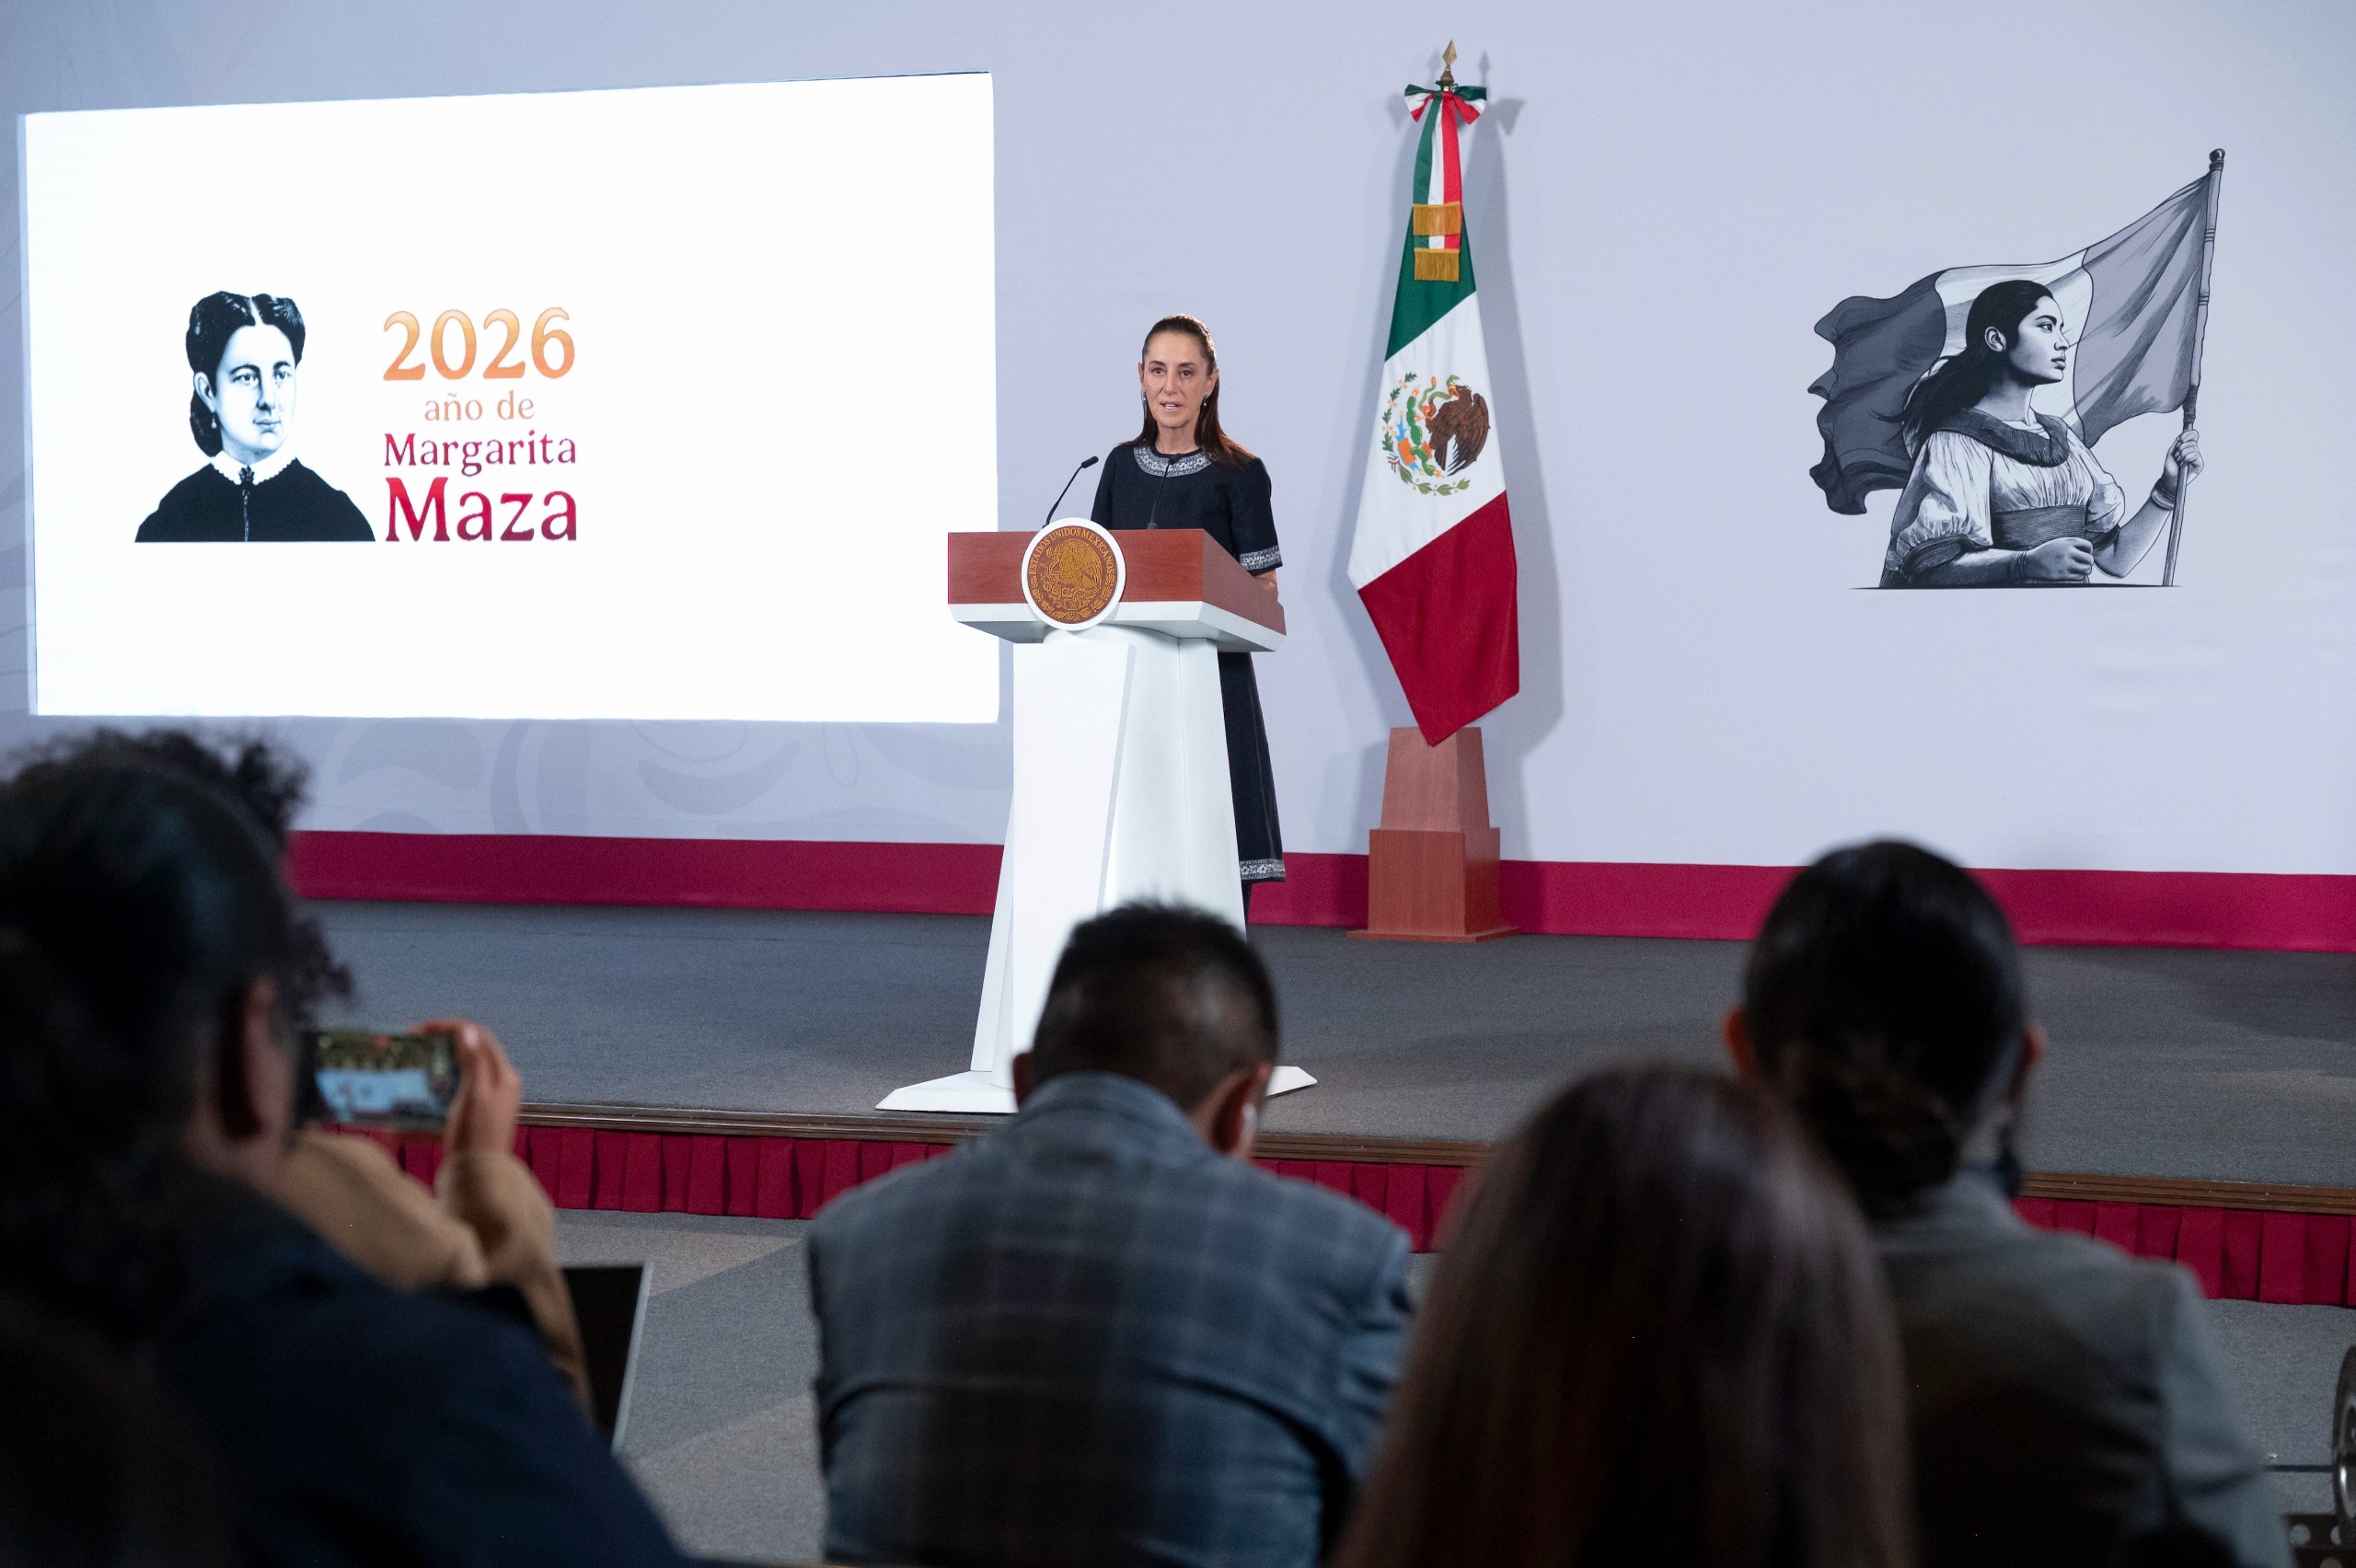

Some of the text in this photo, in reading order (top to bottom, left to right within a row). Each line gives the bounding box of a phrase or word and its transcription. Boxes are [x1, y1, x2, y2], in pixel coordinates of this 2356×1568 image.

[383, 306, 575, 381] 2026
[424, 389, 535, 421] año de
[384, 429, 576, 478] Margarita
[385, 476, 577, 542] Maza
[1029, 527, 1115, 575] ESTADOS UNIDOS MEXICANOS
